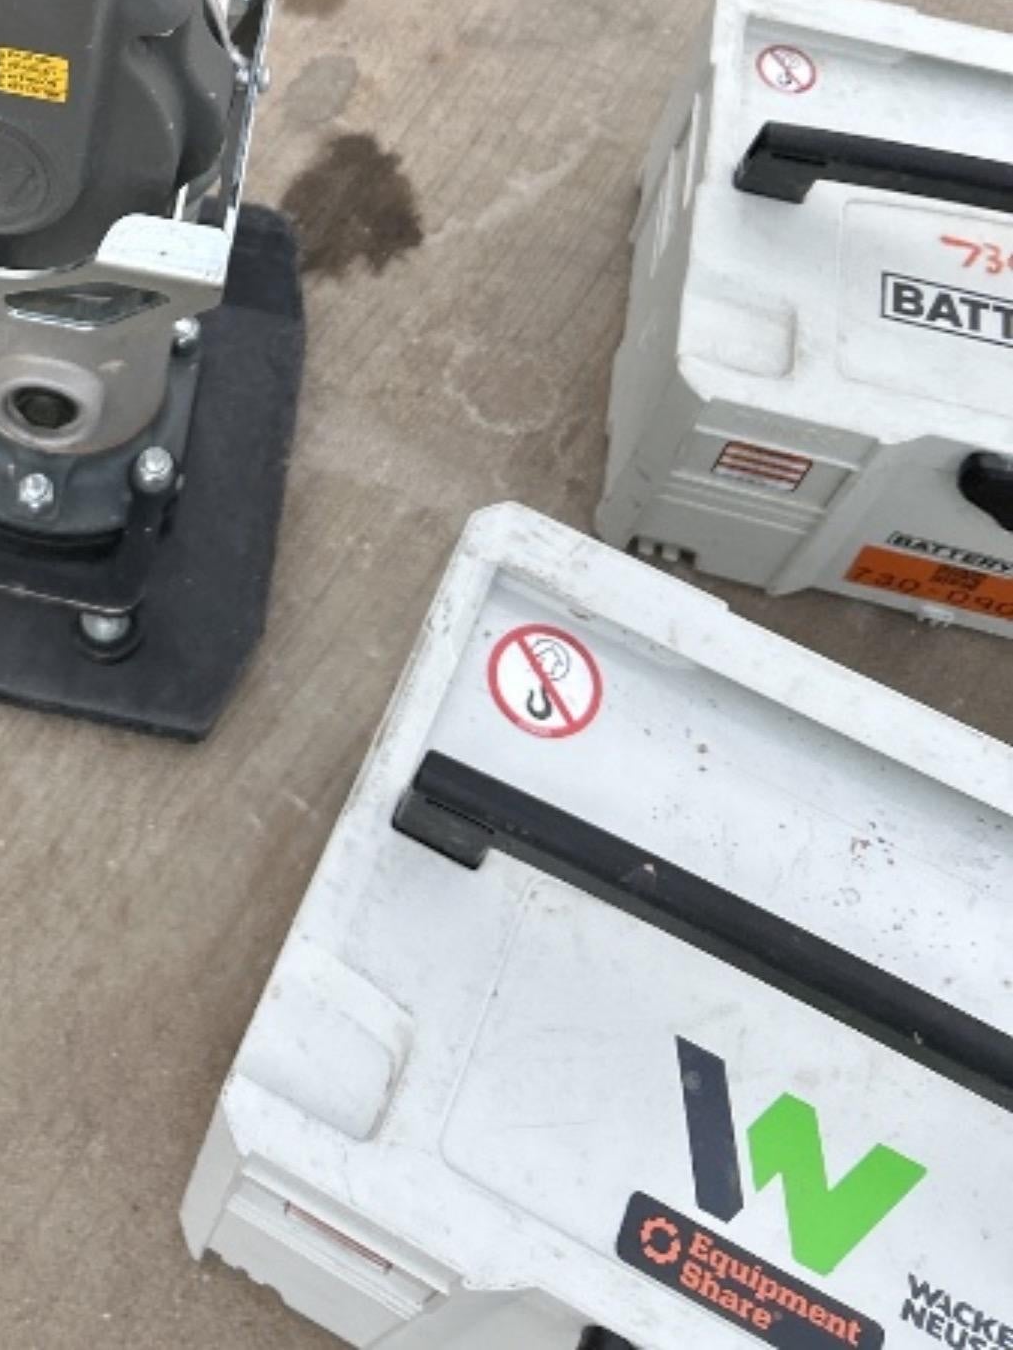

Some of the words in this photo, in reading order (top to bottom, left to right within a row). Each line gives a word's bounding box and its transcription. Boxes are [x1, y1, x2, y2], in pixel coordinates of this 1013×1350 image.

[939, 235, 1013, 274] 73
[892, 281, 1013, 339] BATT
[689, 1232, 862, 1347] Equipment
